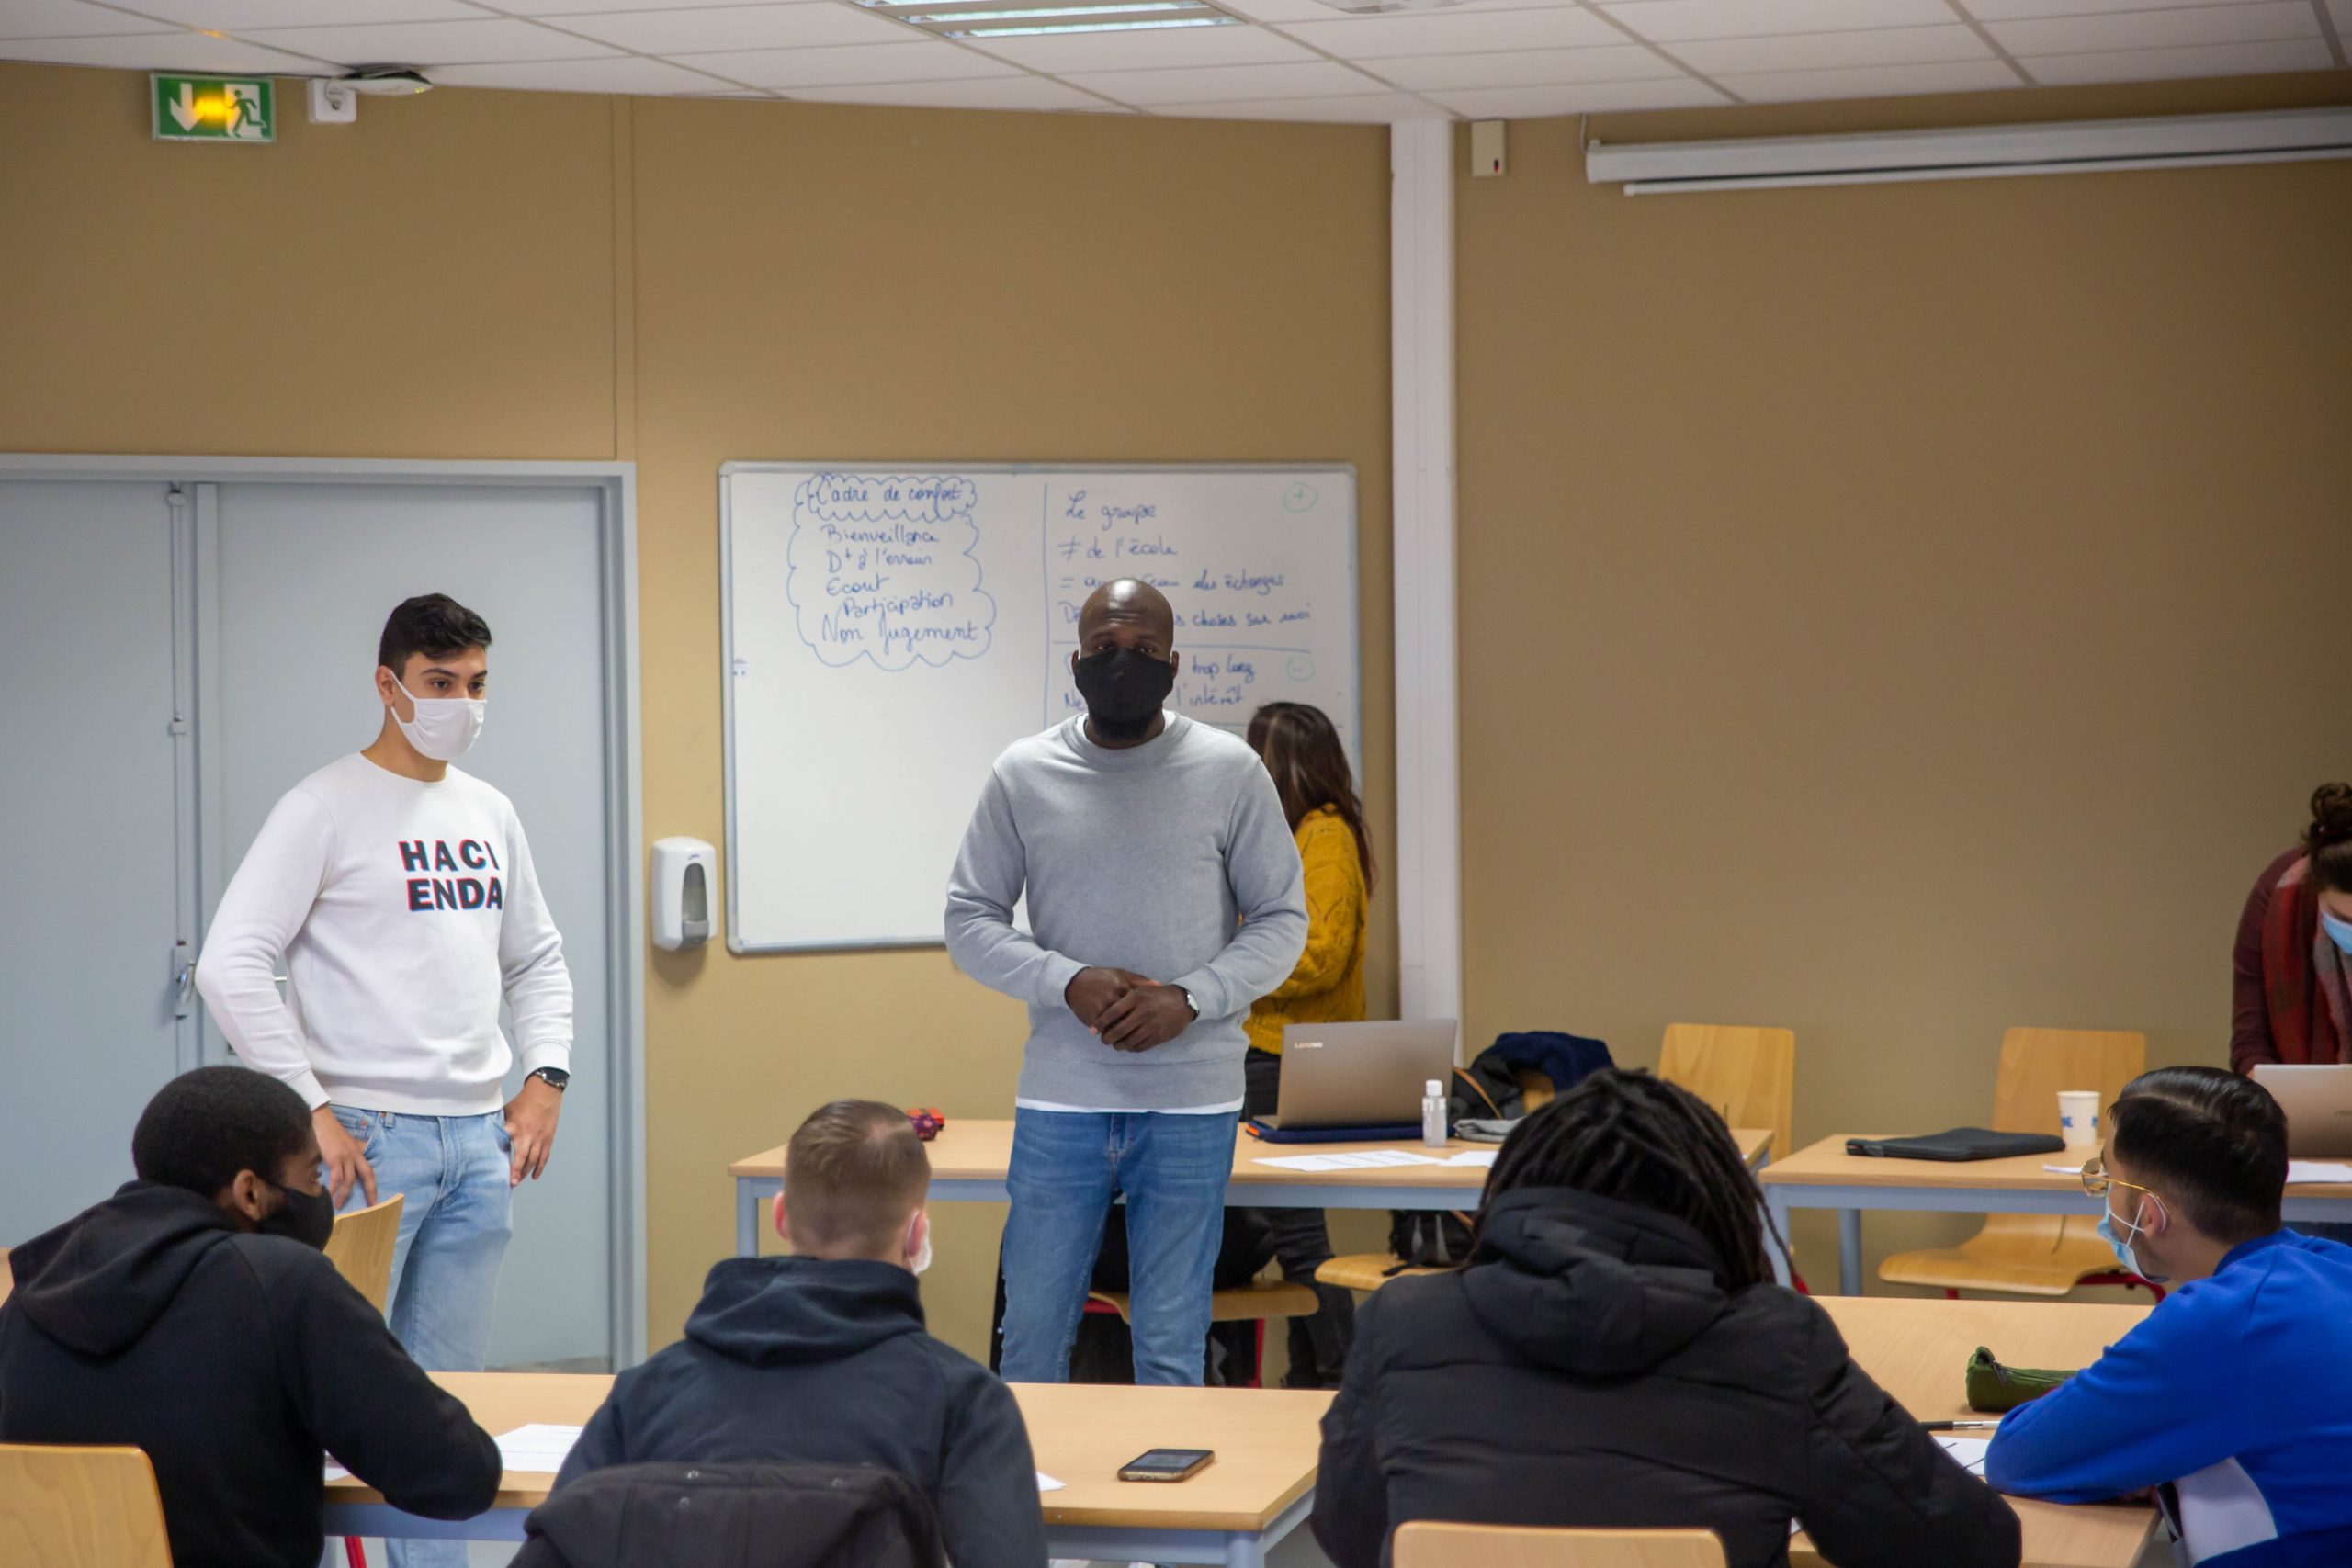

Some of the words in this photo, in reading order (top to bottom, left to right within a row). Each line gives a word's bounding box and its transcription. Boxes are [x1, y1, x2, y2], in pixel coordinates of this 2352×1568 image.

[817, 477, 869, 506] Cadre
[883, 484, 901, 502] de
[908, 482, 964, 517] confort
[1101, 504, 1157, 532] groupe
[1086, 536, 1105, 559] de
[821, 607, 865, 644] Non
[398, 839, 500, 872] HACI
[406, 875, 503, 912] ENDA
